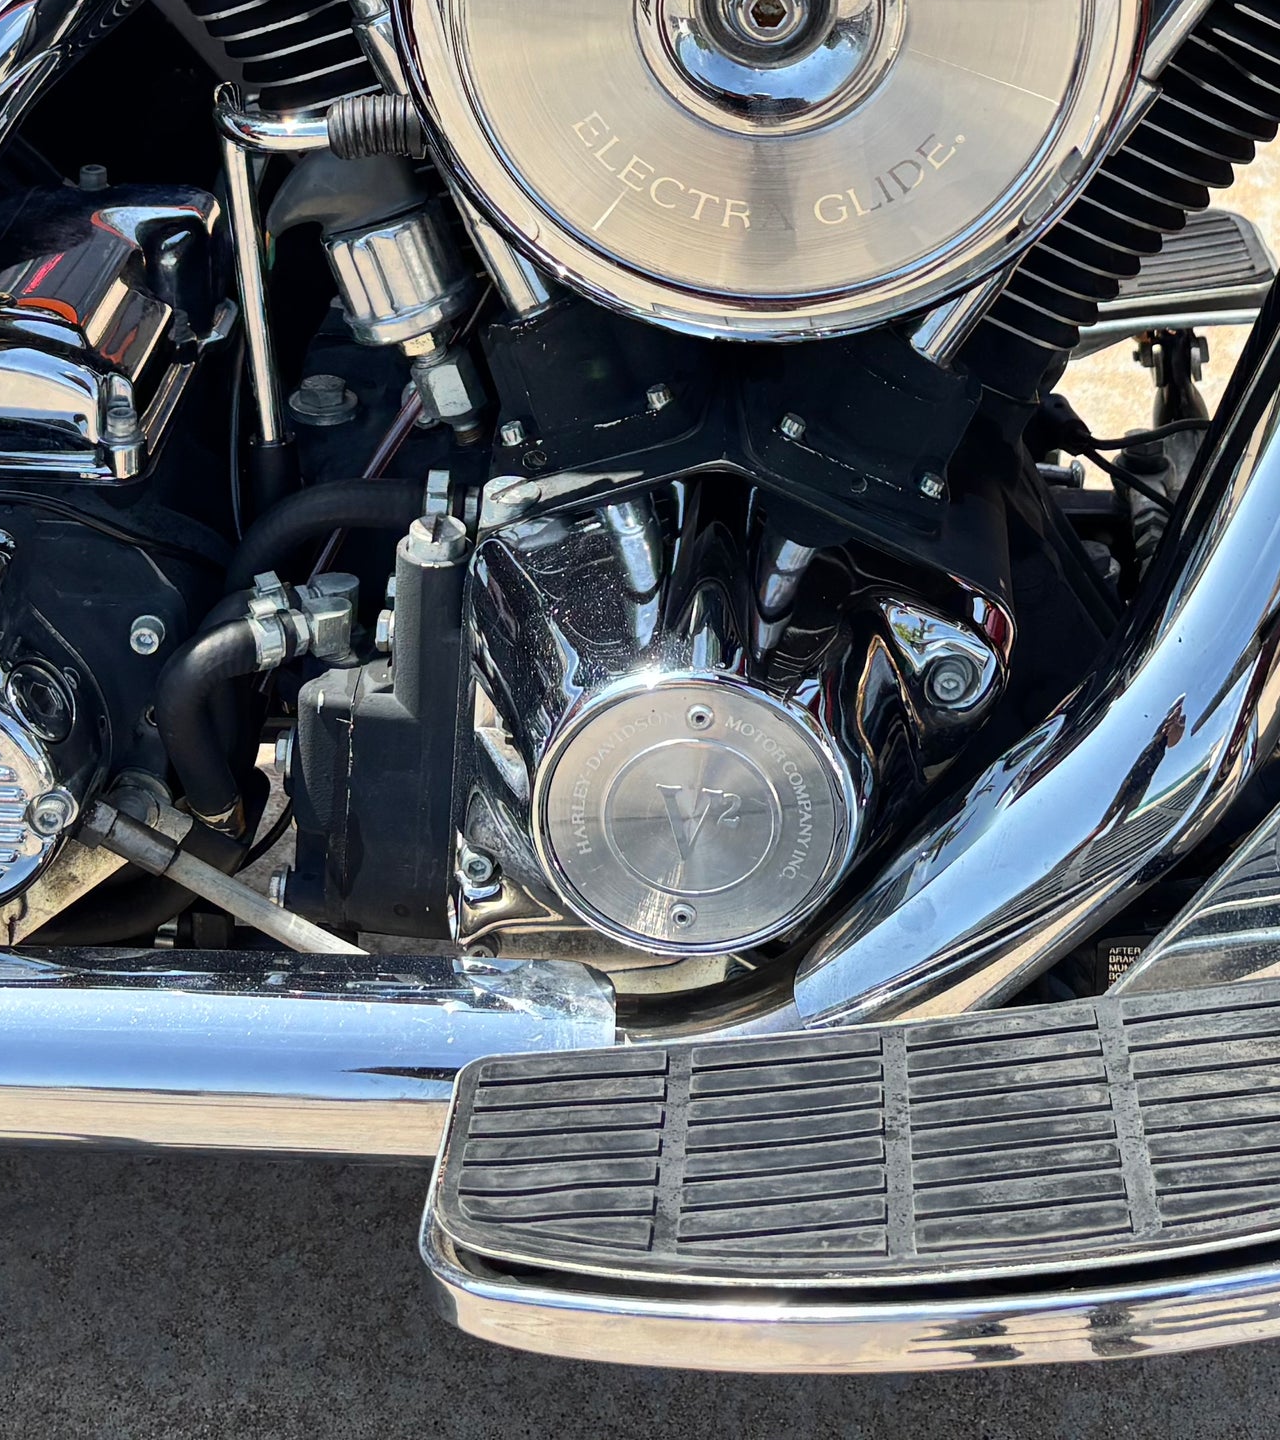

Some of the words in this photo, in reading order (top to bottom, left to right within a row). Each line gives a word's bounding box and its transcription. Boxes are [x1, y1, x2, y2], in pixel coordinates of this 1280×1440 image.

[571, 110, 798, 232] ELECTRA
[571, 711, 677, 855] HARLEY-DAVIDSON
[724, 715, 787, 763] MOTOR
[782, 760, 813, 849] COMPANY
